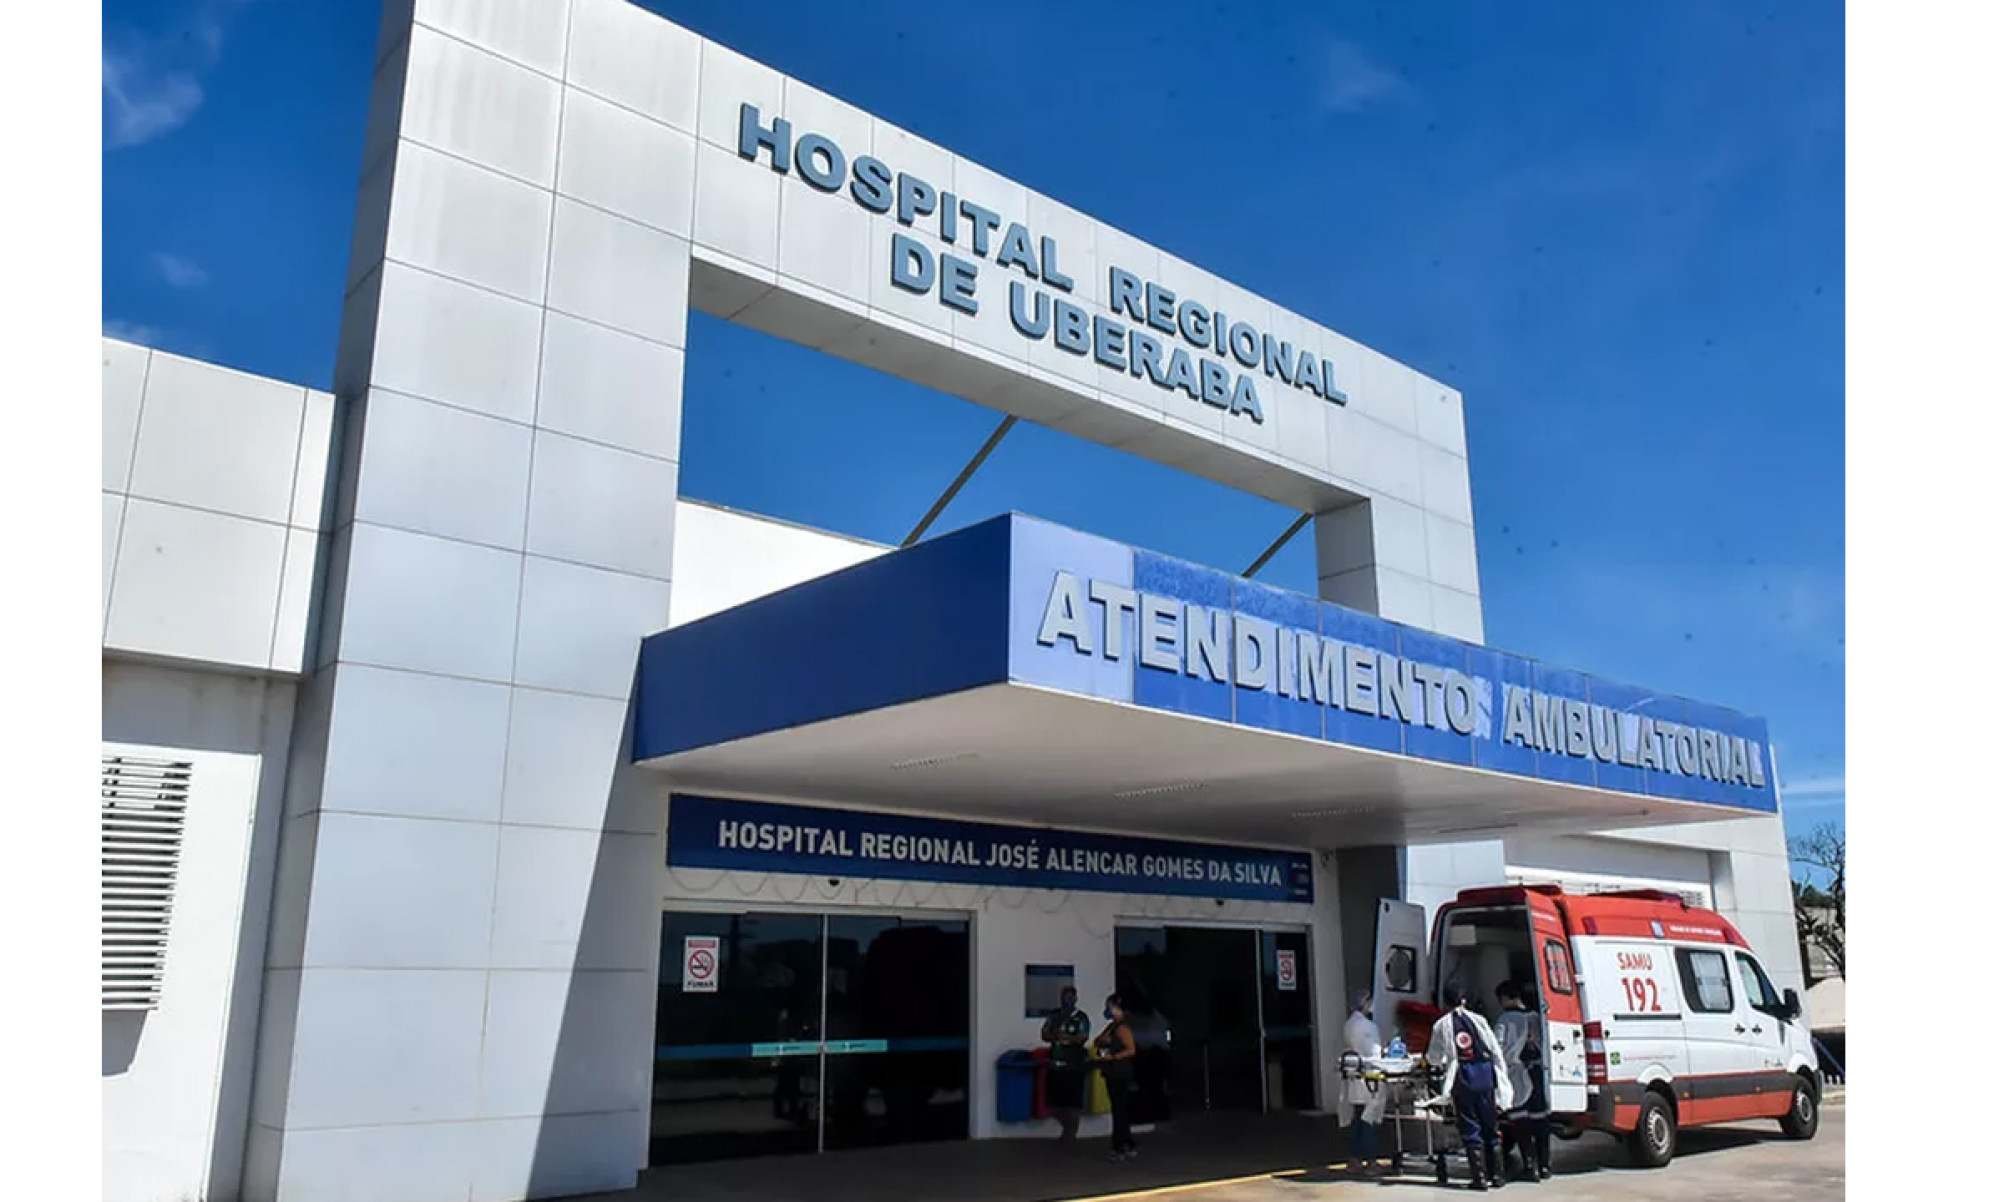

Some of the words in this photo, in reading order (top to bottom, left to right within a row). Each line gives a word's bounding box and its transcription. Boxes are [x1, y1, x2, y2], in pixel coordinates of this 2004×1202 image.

[738, 103, 1074, 292] HOSPITAL
[1109, 265, 1348, 405] REGIONAL
[891, 233, 979, 317] DE
[1010, 280, 1264, 424] UBERABA
[1037, 570, 1477, 735] ATENDIMENTO
[1503, 682, 1766, 789] AMBULATORIAL
[718, 820, 853, 857] HOSPITAL
[861, 832, 981, 866] REGIONAL
[986, 839, 1040, 869] JOSÉ
[1046, 848, 1138, 876] ALENCAR
[1143, 856, 1205, 881] GOMES
[1208, 860, 1232, 882] DA
[1235, 863, 1282, 886] SILVA
[1617, 951, 1653, 971] SAMU
[1621, 977, 1662, 1013] 192
